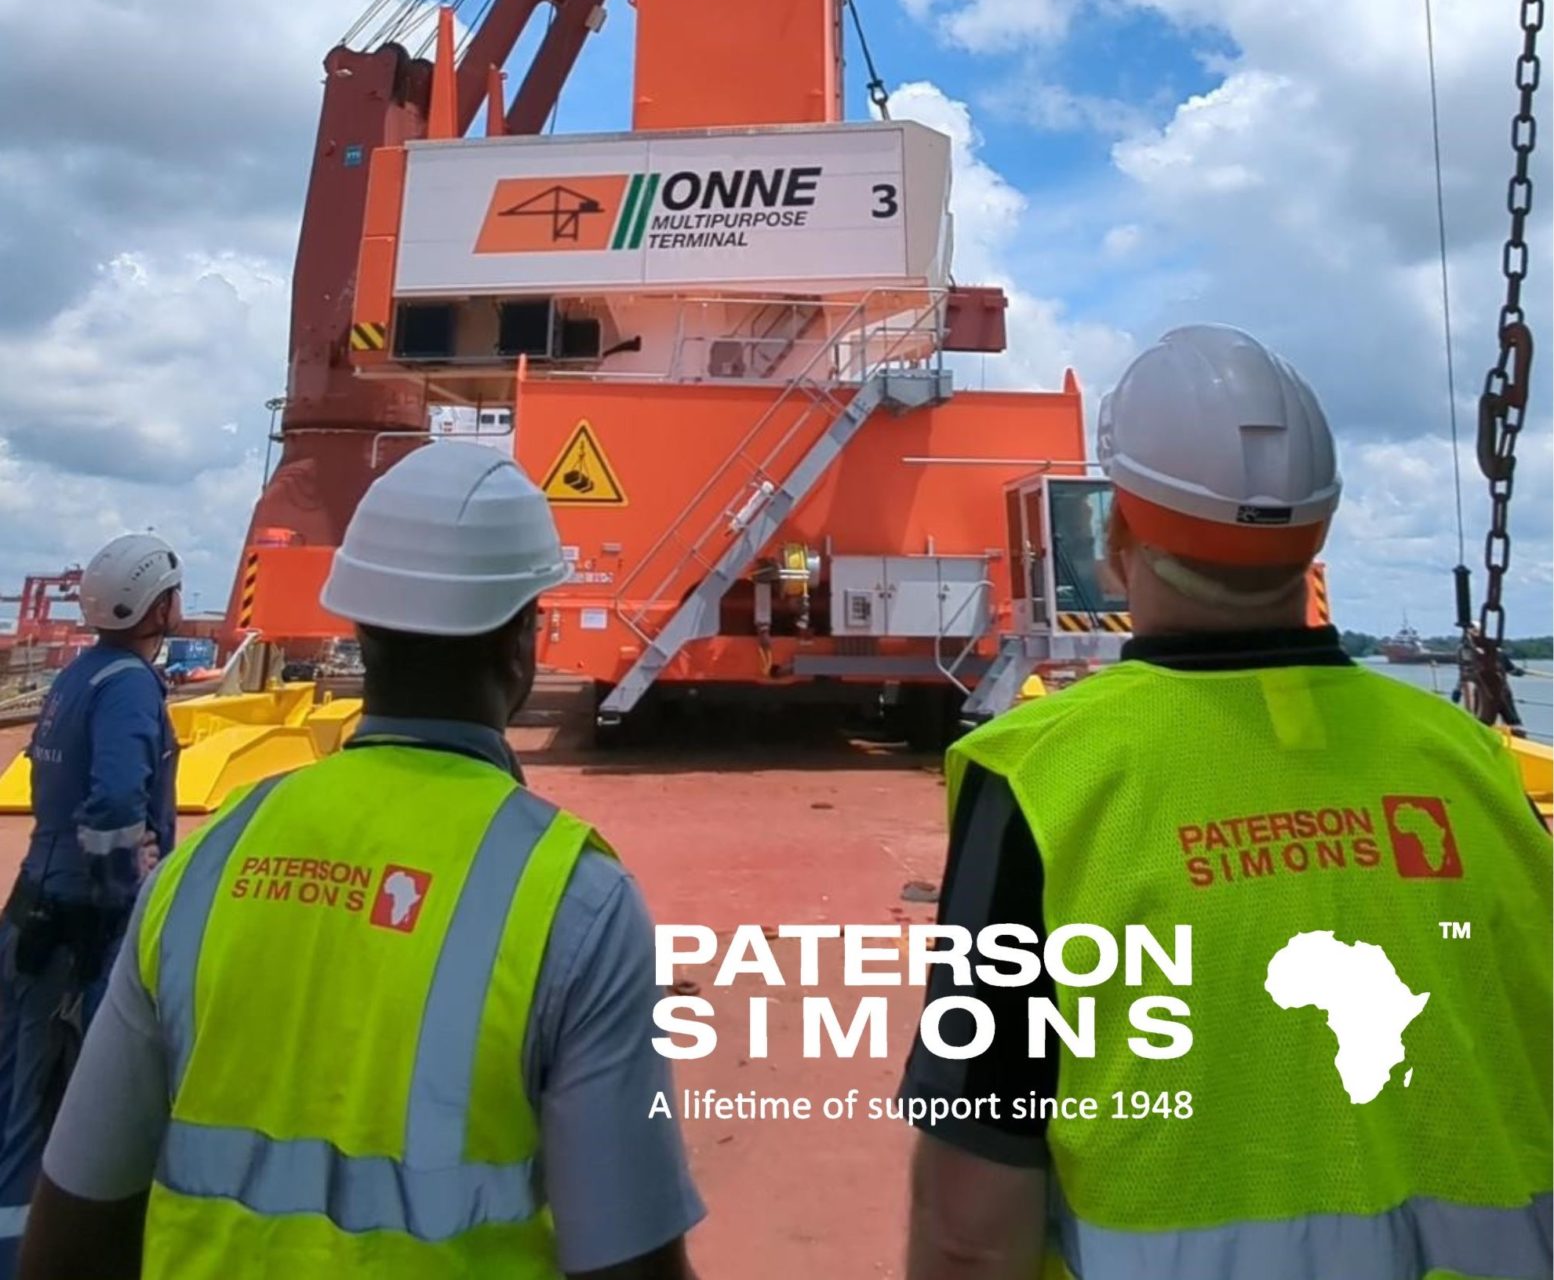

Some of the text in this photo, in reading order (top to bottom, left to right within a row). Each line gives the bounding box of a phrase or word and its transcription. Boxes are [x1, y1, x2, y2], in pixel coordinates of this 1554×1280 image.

[661, 167, 823, 211] ONNE
[871, 183, 898, 219] 3
[651, 211, 807, 230] MULTIPURPOSE
[648, 231, 749, 249] TERMINAL
[1179, 808, 1373, 854] PATERSON
[241, 857, 372, 888] PATERSON
[1187, 839, 1380, 886] SIMONS
[231, 878, 366, 911] SIMONS
